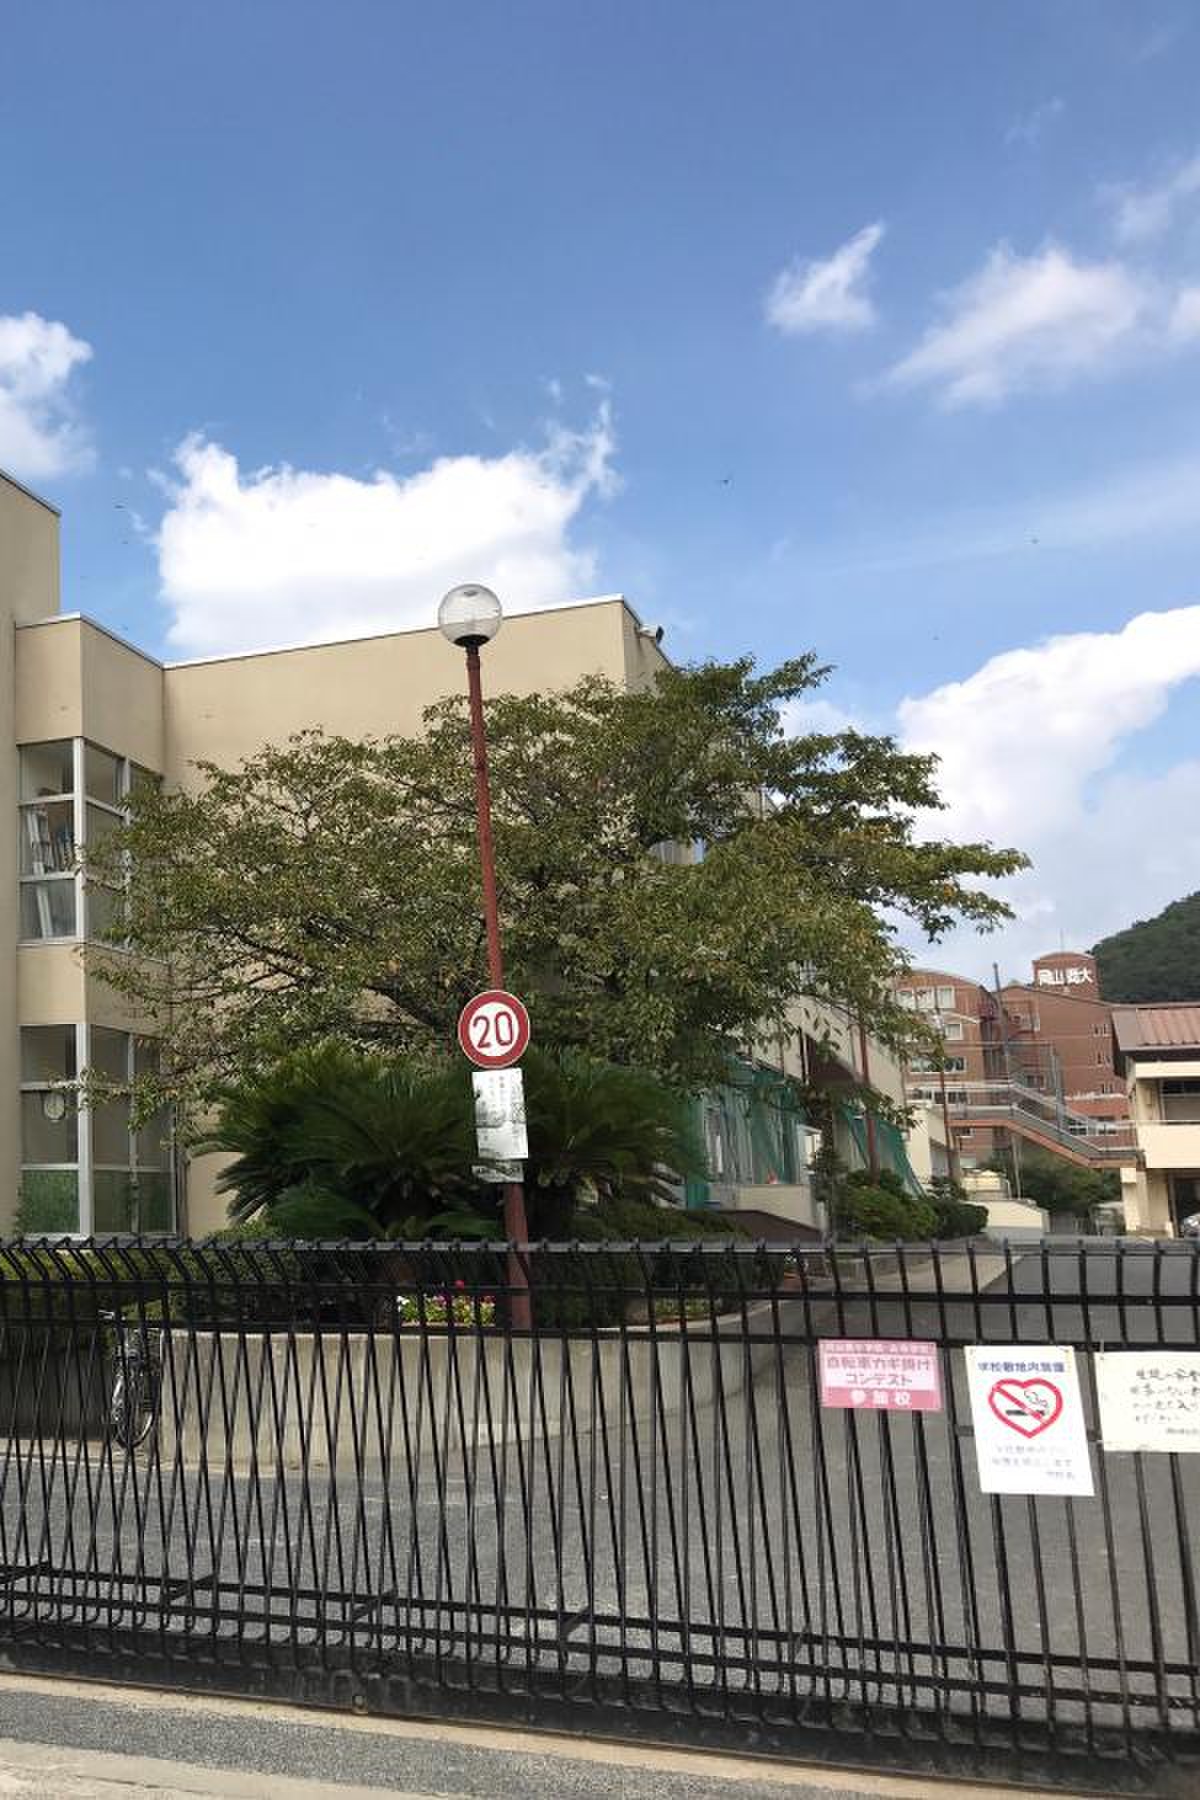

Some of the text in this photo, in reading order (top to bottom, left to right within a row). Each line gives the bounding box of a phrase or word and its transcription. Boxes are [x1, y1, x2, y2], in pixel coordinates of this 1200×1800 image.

[472, 1011, 514, 1049] 20
[846, 1372, 913, 1387] コンテスト
